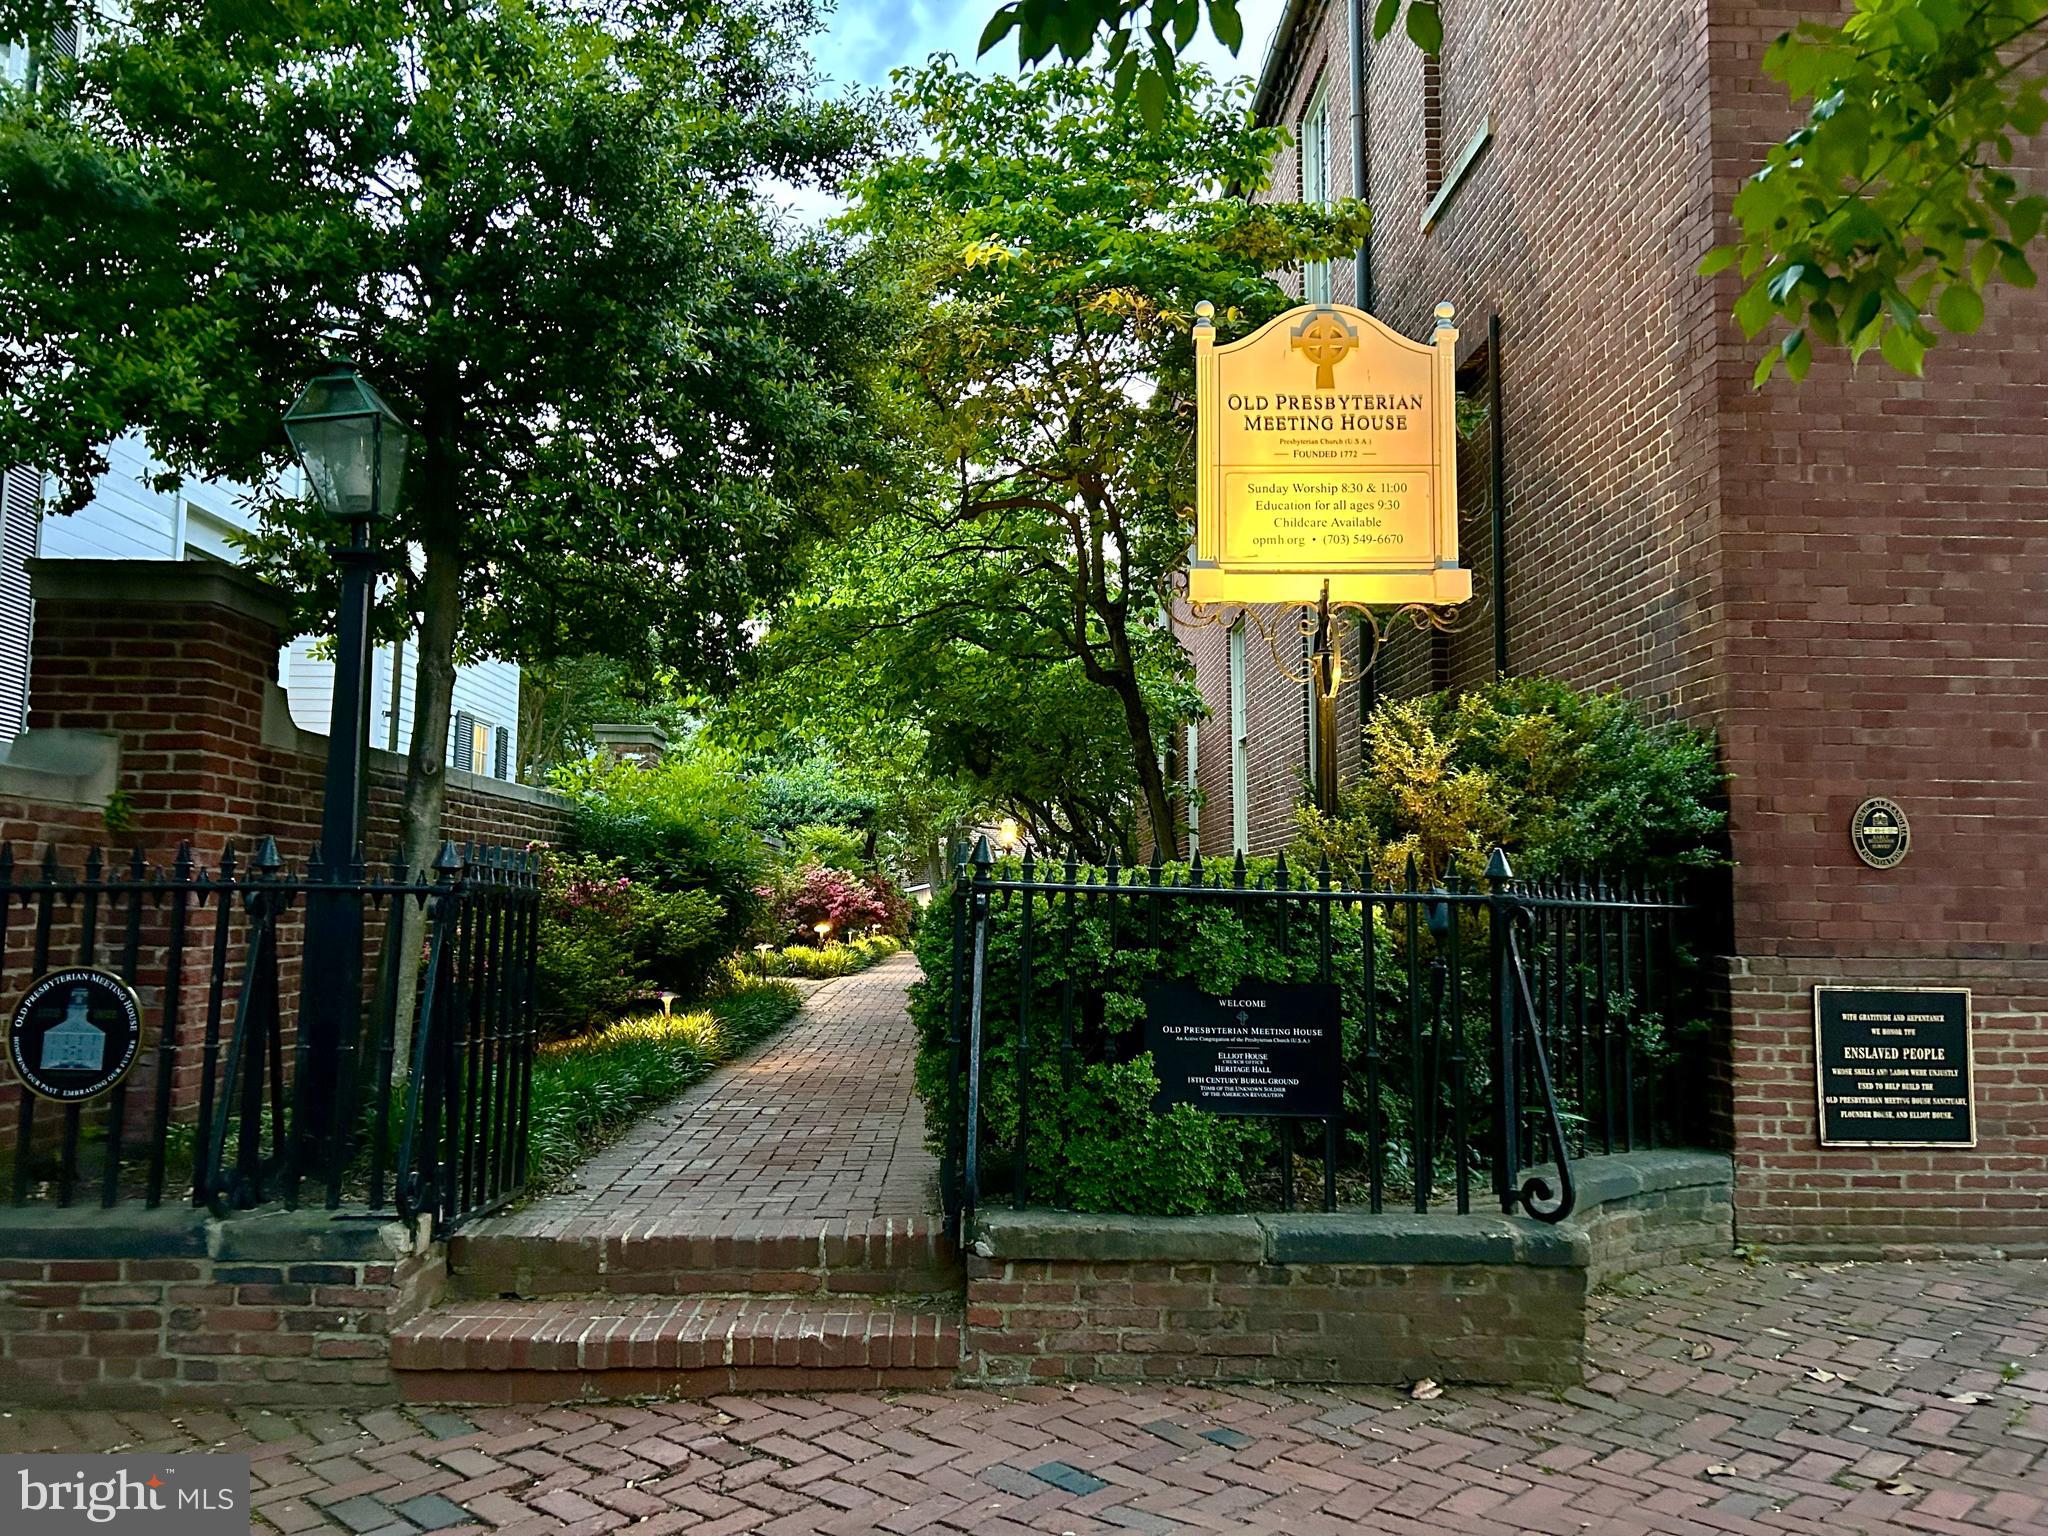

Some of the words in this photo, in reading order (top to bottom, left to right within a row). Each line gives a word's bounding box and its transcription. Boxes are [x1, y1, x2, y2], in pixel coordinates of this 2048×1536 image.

[1228, 394, 1268, 410] OLD
[1276, 394, 1423, 410] PRESBYTERIAN
[1244, 415, 1333, 431] MEETING
[1341, 414, 1407, 430] HOUSE
[1248, 483, 1288, 495] Sunday
[1293, 483, 1338, 495] Worship
[1342, 483, 1363, 493] 8:30
[1367, 483, 1376, 493] &
[1381, 483, 1407, 493] 11:00
[1256, 501, 1311, 510] Education
[1315, 501, 1330, 510] for
[1333, 501, 1346, 510] all
[1350, 503, 1374, 512] ages
[1378, 500, 1400, 510] 9:30
[1274, 518, 1327, 527] Childcare
[1331, 518, 1382, 527] Available
[1253, 535, 1305, 547] opmh.org
[1323, 535, 1349, 545] (703)
[1353, 535, 1403, 544] 549-6670
[15, 1008, 28, 1027] OLD
[25, 973, 89, 1007] PRESBYTERIAN
[90, 973, 126, 1000] MEETING
[123, 1000, 138, 1031] HOUSE
[1184, 1026, 1248, 1035] PRESBYTERIAN
[1844, 1047, 1899, 1059] ENSLAVED
[1903, 1048, 1945, 1060] PEOPLE
[27, 1072, 40, 1086] OUR
[40, 1083, 59, 1094] PAST
[62, 1079, 108, 1096] EMBRACING
[108, 1068, 122, 1081] OUR
